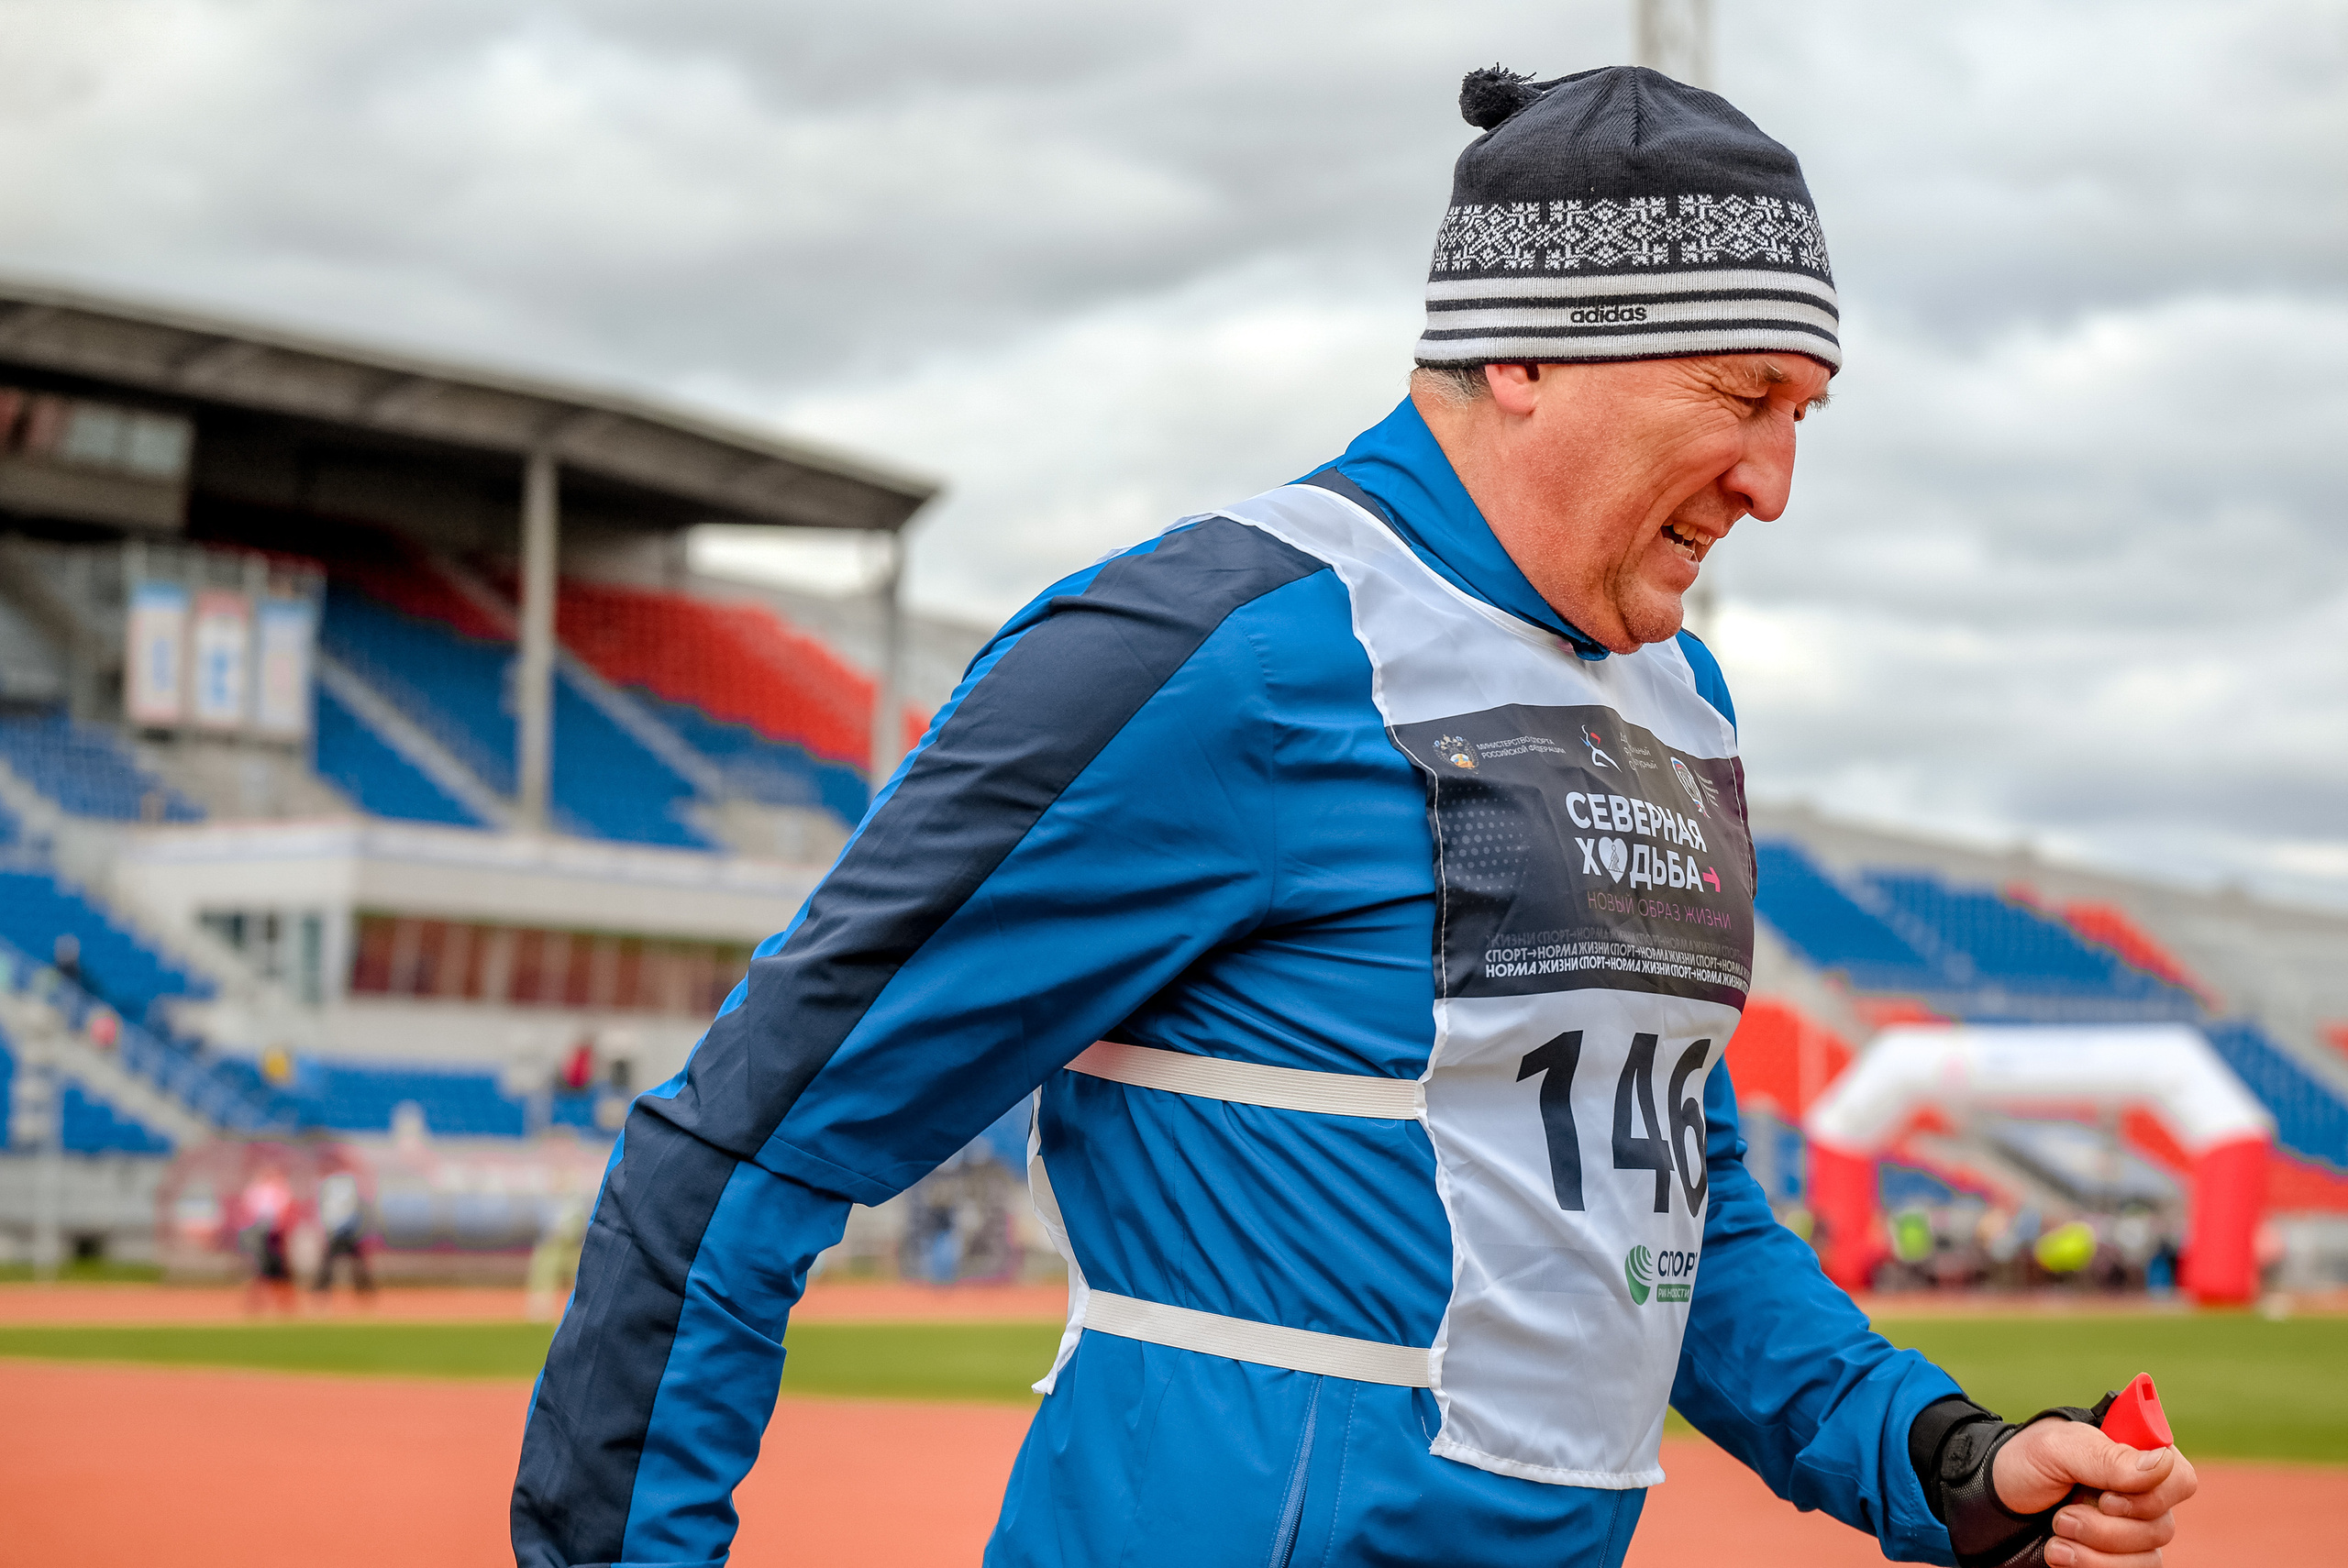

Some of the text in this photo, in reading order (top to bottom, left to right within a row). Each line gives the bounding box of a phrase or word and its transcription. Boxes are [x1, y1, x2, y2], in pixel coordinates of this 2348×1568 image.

[1570, 305, 1647, 324] adidas
[1476, 735, 1556, 750] МИНИСТЕРСТВО СПОРТА
[1481, 745, 1529, 759] РОССИЙСКОЙ
[1565, 791, 1708, 853] СЕВЕРНАЯ
[1588, 890, 1732, 930] НОВЫЙ ОБРАЗ ЖИЗНИ
[1486, 932, 1535, 947] ЖИЗНИ
[1537, 929, 1569, 944] СПОРТ
[1577, 926, 1609, 942] НОРМА
[1485, 947, 1528, 963] СПОРТ
[1537, 943, 1578, 959] НОРМА
[1578, 941, 1610, 955] ЖИЗНИ
[1611, 942, 1635, 957] СПОРТ
[1640, 946, 1669, 962] НОРМА
[1668, 950, 1695, 966] ЖИЗНИ
[1696, 955, 1718, 970] СПОРТ
[1486, 961, 1536, 977] НОРМА
[1538, 956, 1578, 974] ЖИЗНИ
[1578, 955, 1605, 970] СПОРТ
[1611, 956, 1641, 973] НОРМА
[1642, 959, 1670, 977] ЖИЗНИ
[1671, 964, 1691, 979] СПОРТ
[1696, 968, 1722, 985] НОРМА
[1516, 1030, 1708, 1218] 146
